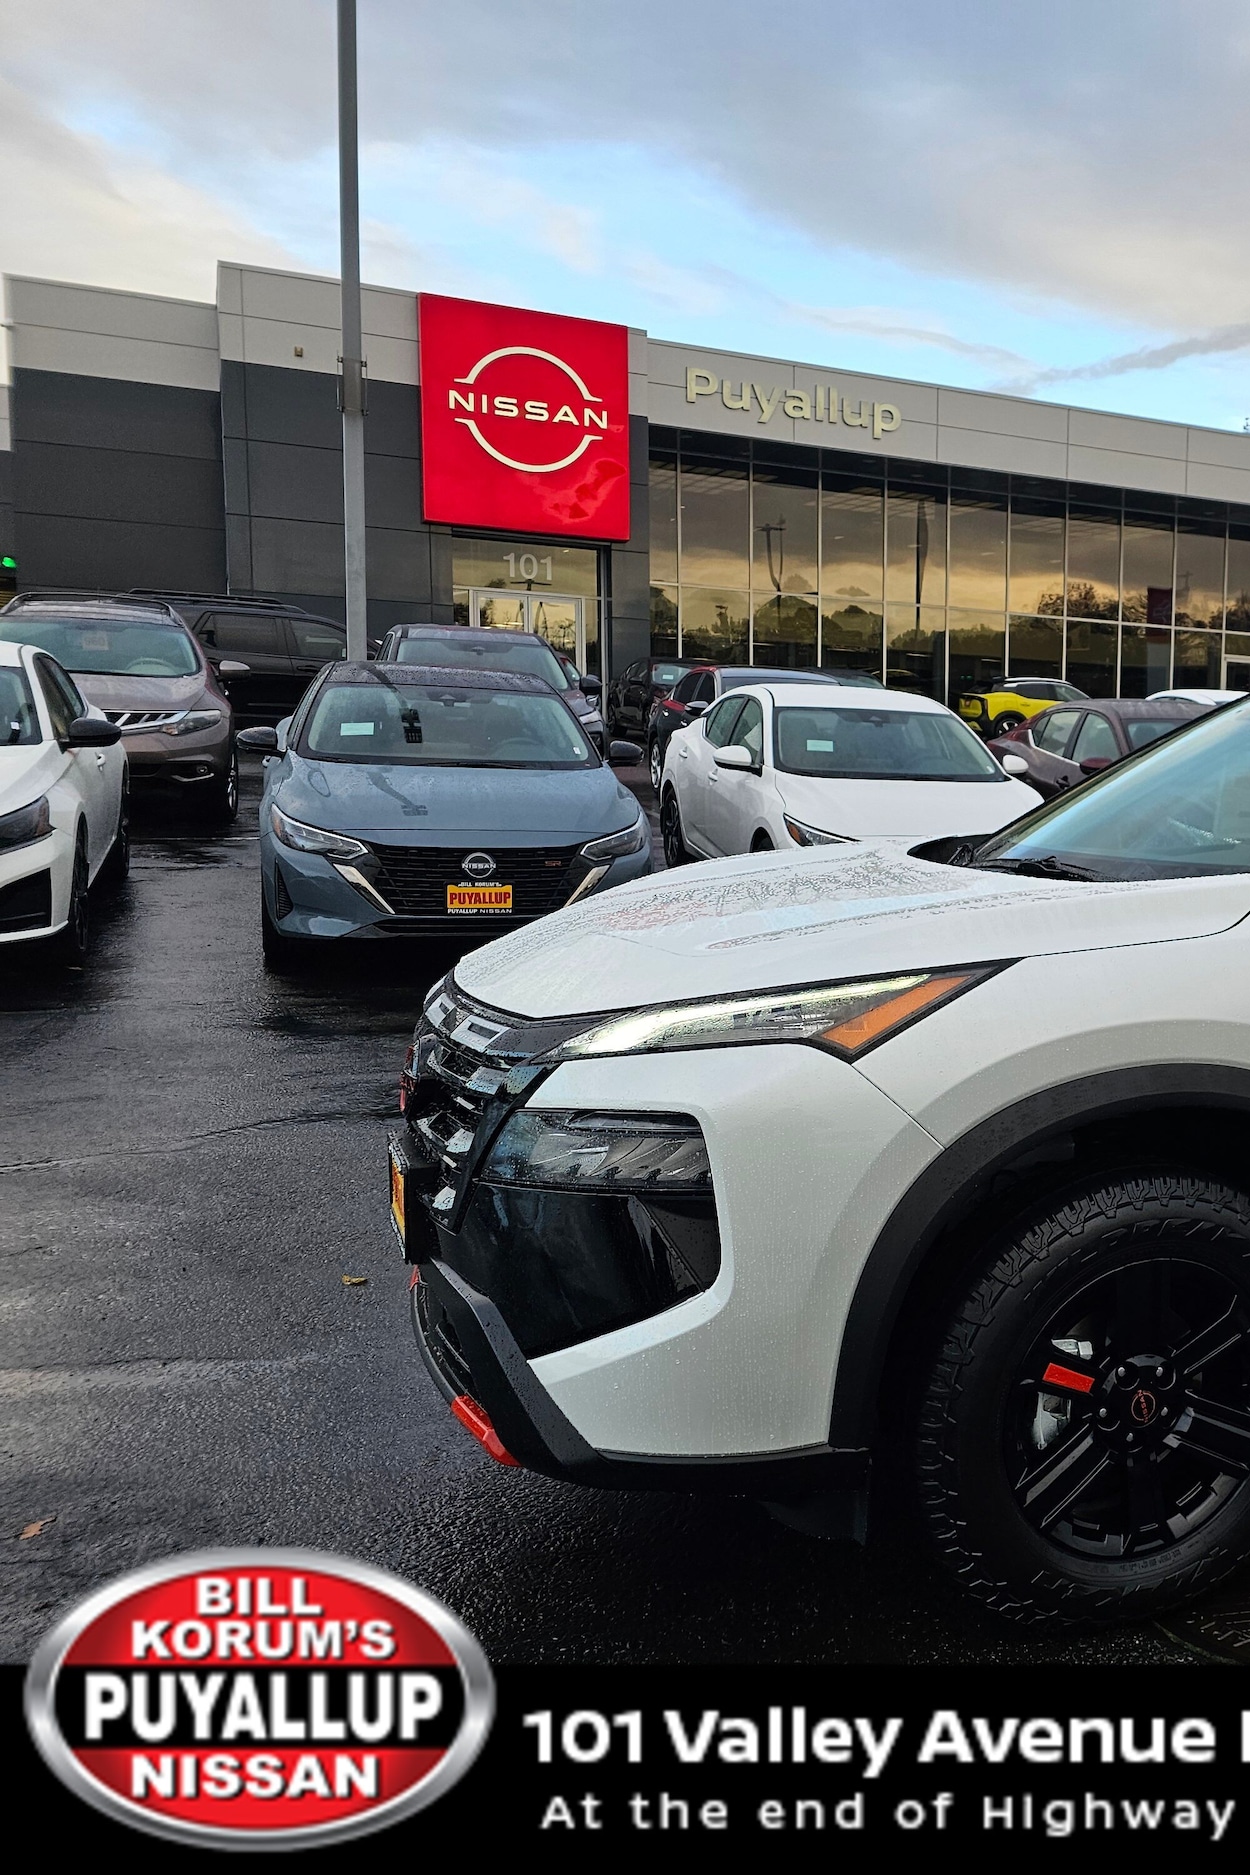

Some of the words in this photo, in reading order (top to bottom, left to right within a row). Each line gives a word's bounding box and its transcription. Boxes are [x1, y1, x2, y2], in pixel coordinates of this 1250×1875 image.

[448, 389, 608, 430] NISSAN
[685, 366, 902, 440] Puyallup
[502, 552, 553, 581] 101
[461, 862, 497, 870] NISSAN
[449, 891, 511, 905] PUYALLUP
